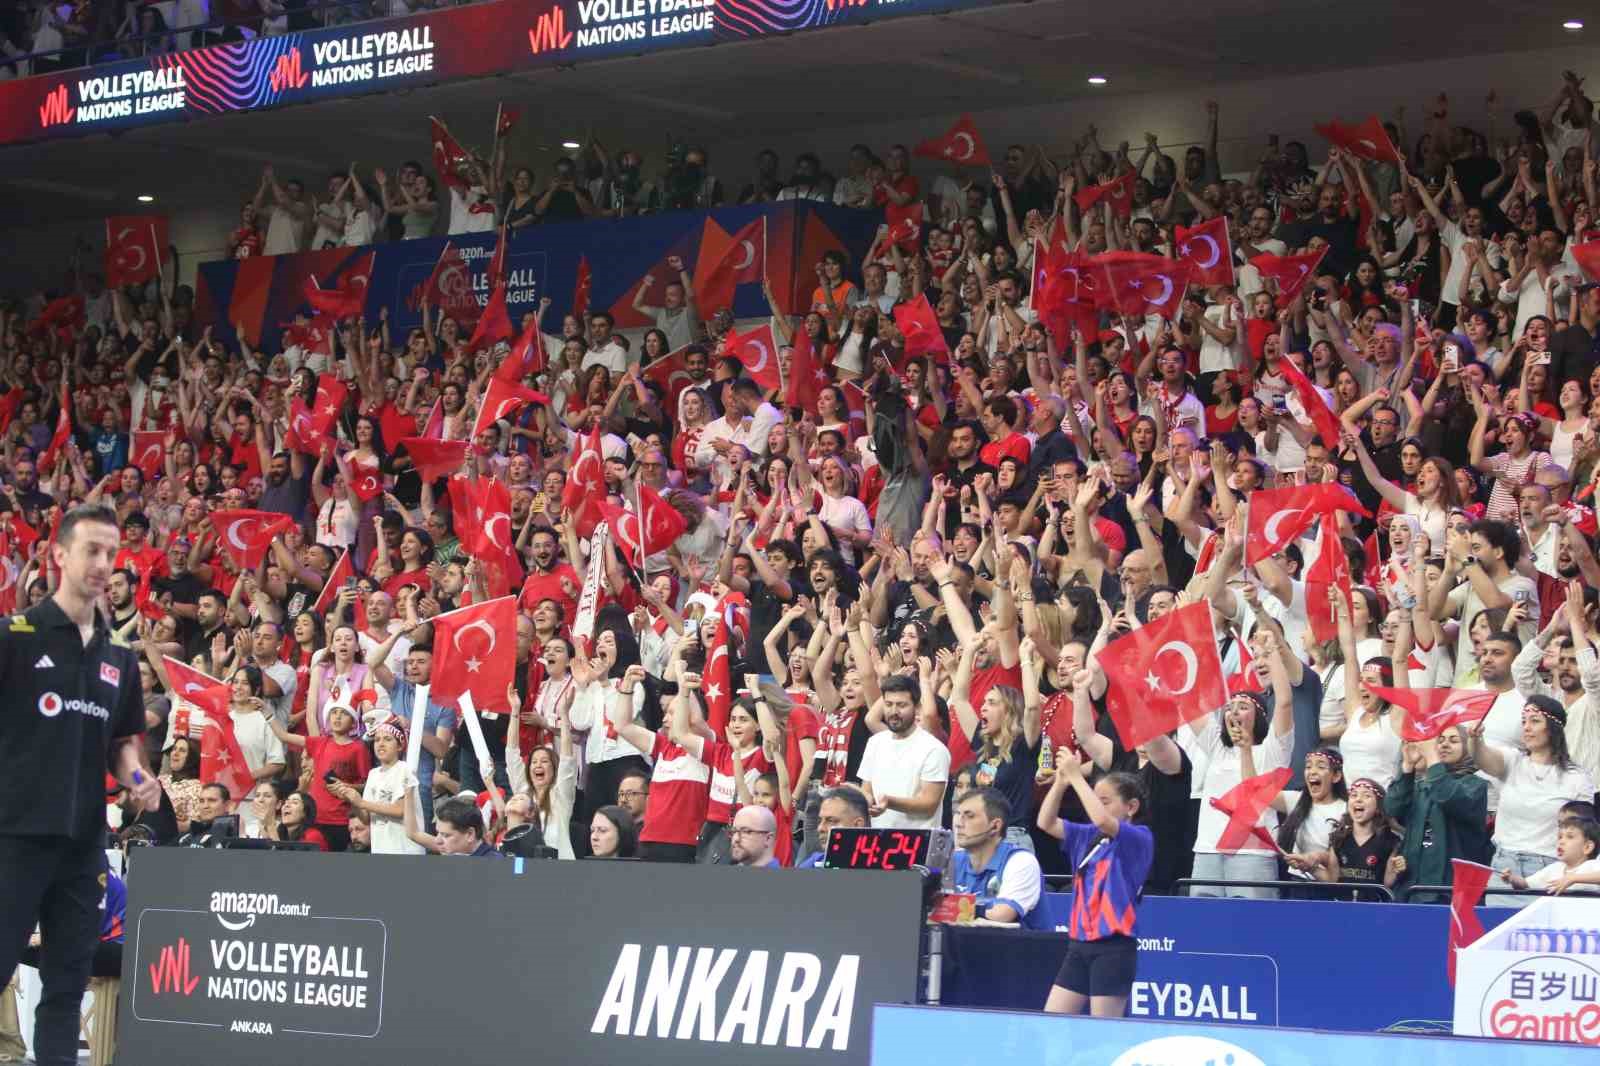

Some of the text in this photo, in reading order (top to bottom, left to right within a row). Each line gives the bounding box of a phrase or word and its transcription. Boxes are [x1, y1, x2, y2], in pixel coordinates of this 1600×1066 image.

[576, 11, 715, 48] NATIONS LEAGUE
[577, 0, 715, 25] VOLLEYB
[313, 25, 434, 65] VOLLEYBALL
[78, 65, 187, 102] VOLLEYBALL
[311, 52, 434, 87] NATIONS LEAGUE
[77, 91, 185, 122] NATIONS LEAGUE
[850, 832, 922, 870] 14:24
[210, 890, 312, 916] amazon.com.tr
[210, 939, 368, 979] VOLLEYBALL
[207, 975, 367, 1009] NATIONS LEAGUE
[590, 943, 860, 1051] ANKARA
[1131, 980, 1257, 1021] EYBALL
[1511, 970, 1597, 1001] 百岁山
[230, 1019, 273, 1035] ANKARA
